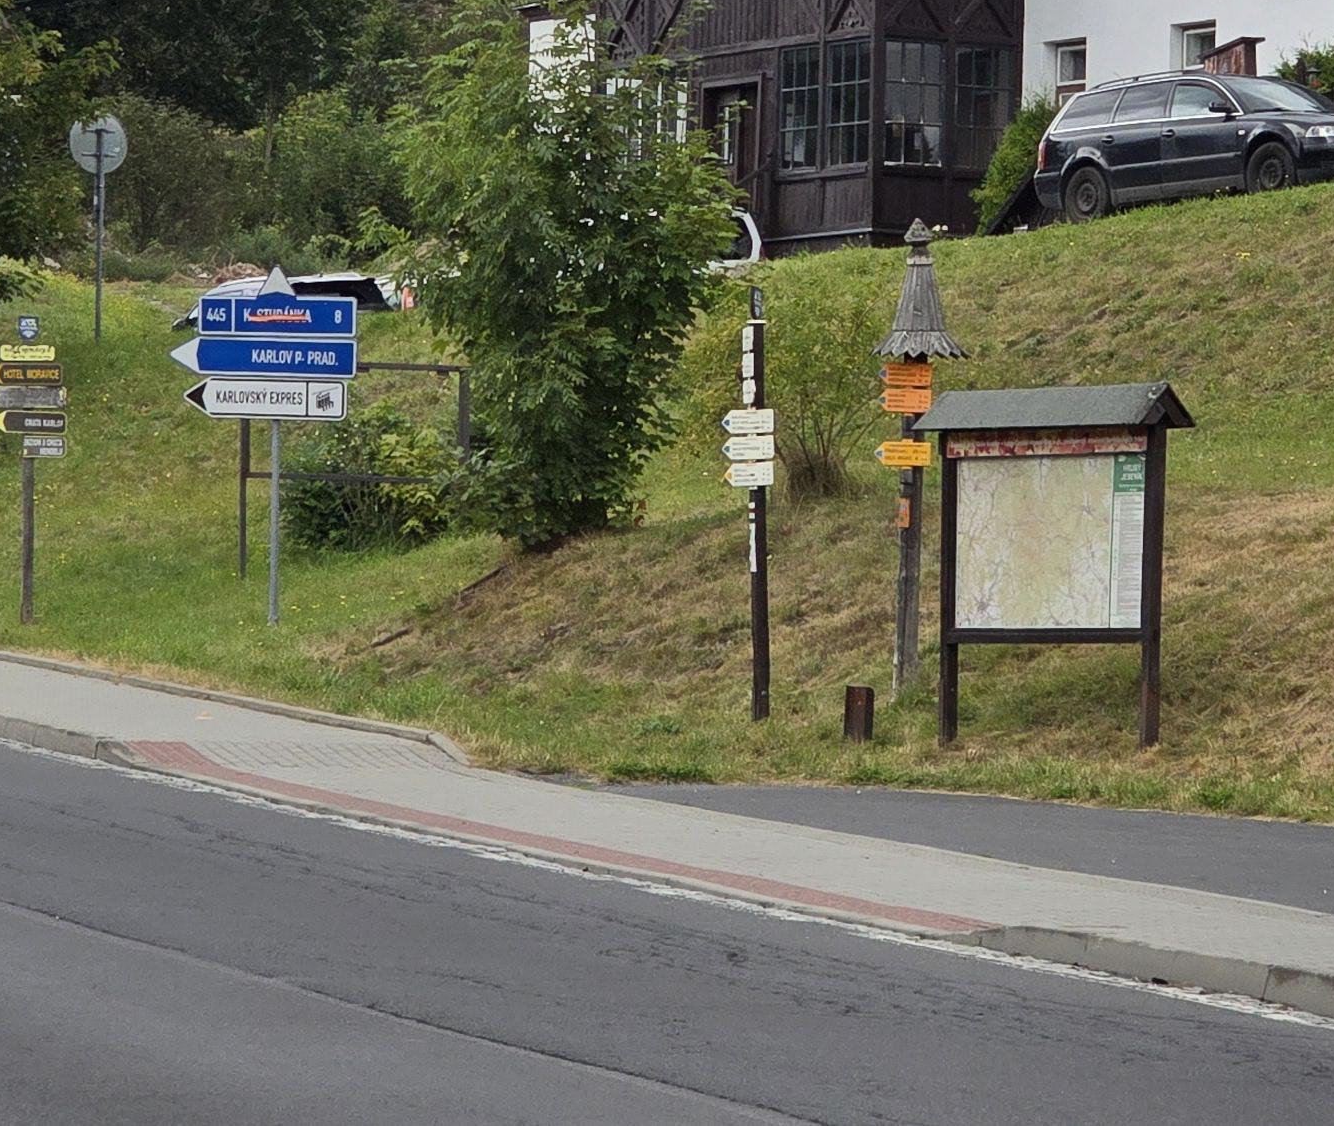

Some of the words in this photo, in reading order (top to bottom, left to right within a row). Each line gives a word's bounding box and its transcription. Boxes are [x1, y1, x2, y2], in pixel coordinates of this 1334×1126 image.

[206, 307, 226, 322] 445
[334, 309, 342, 324] 8
[251, 349, 294, 364] KARLOV
[307, 351, 339, 366] PRAD.
[216, 388, 267, 404] KARLOVSKÝ
[269, 391, 303, 405] EXPRES
